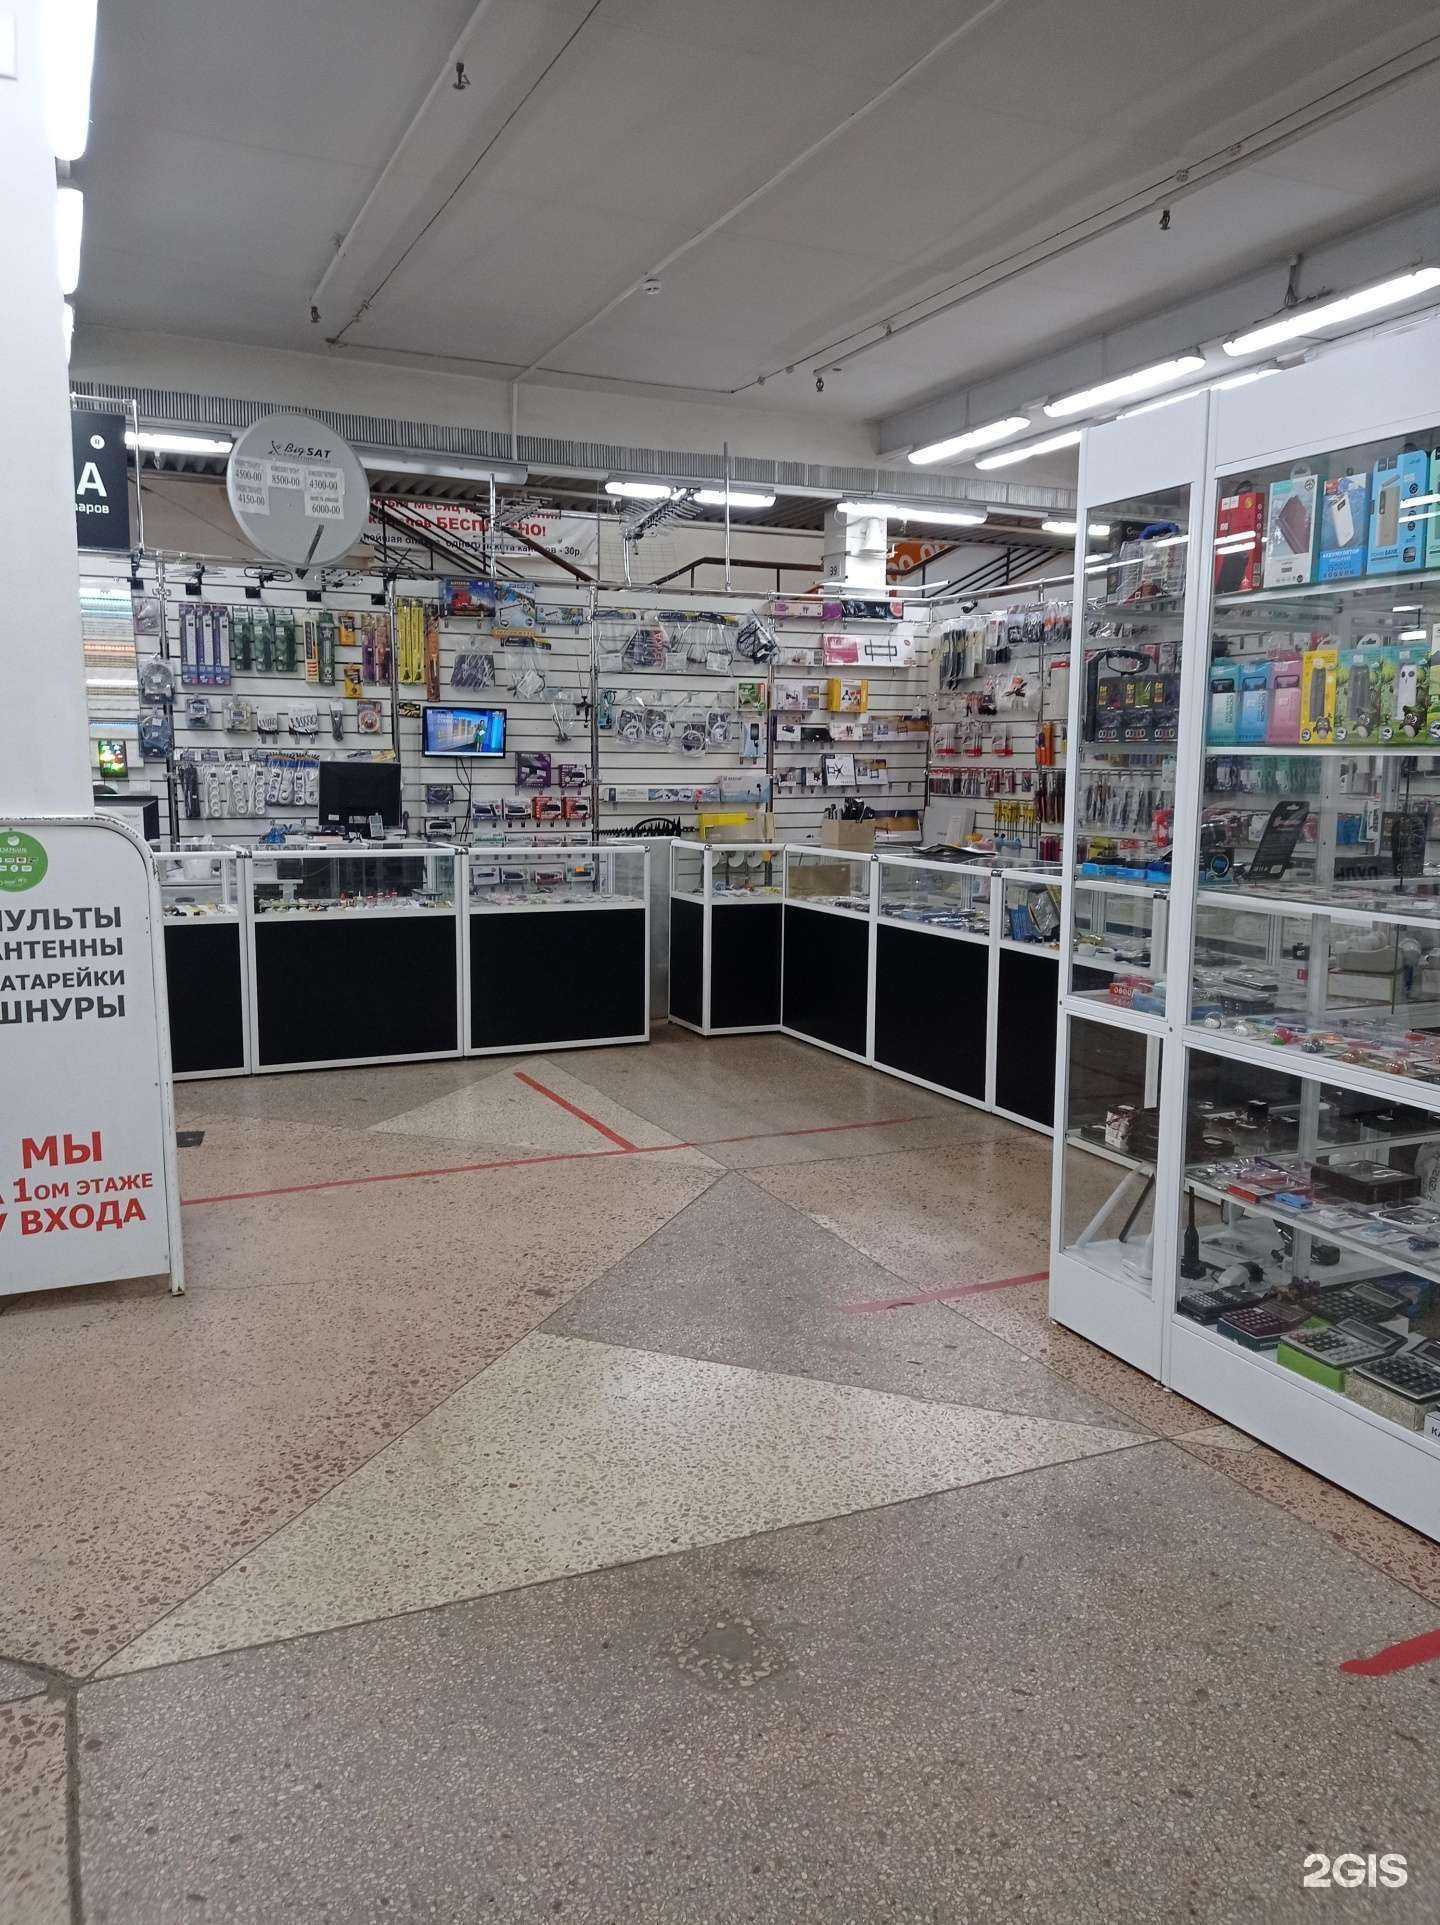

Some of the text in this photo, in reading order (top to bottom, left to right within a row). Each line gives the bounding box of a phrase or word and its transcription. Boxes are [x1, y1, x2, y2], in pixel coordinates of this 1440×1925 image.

[0, 906, 122, 932] УЛЬТЫ
[0, 937, 123, 960] НТЕННЫ
[0, 966, 125, 991] АТАРЕЙКИ
[0, 995, 126, 1025] ШНУРЫ
[22, 1131, 103, 1169] МЫ
[76, 1173, 153, 1196] ЭТАЖЕ
[21, 1198, 146, 1235] ВХОДА
